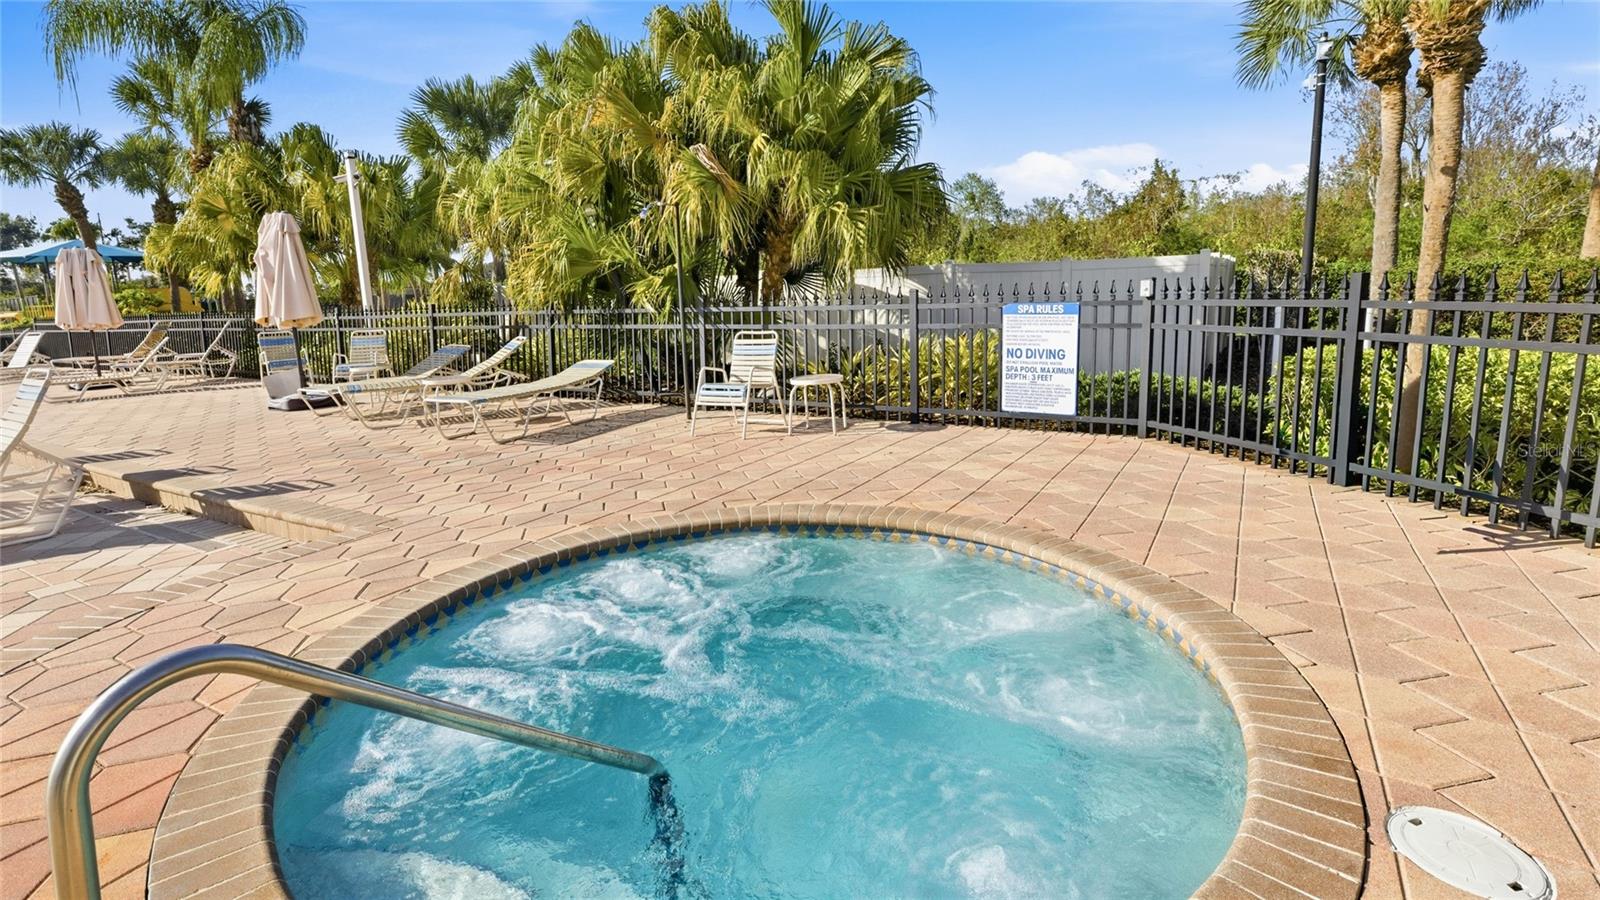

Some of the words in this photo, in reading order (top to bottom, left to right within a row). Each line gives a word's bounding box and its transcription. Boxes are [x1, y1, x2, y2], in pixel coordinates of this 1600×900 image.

[1017, 304, 1035, 314] SPA
[1036, 304, 1064, 314] RULES
[1006, 347, 1023, 359] NO
[1025, 348, 1066, 360] DIVING
[1005, 365, 1018, 373] SPA
[1020, 366, 1038, 374] POOL
[1040, 367, 1075, 375] MAXIMUM
[1037, 374, 1053, 382] FEET
